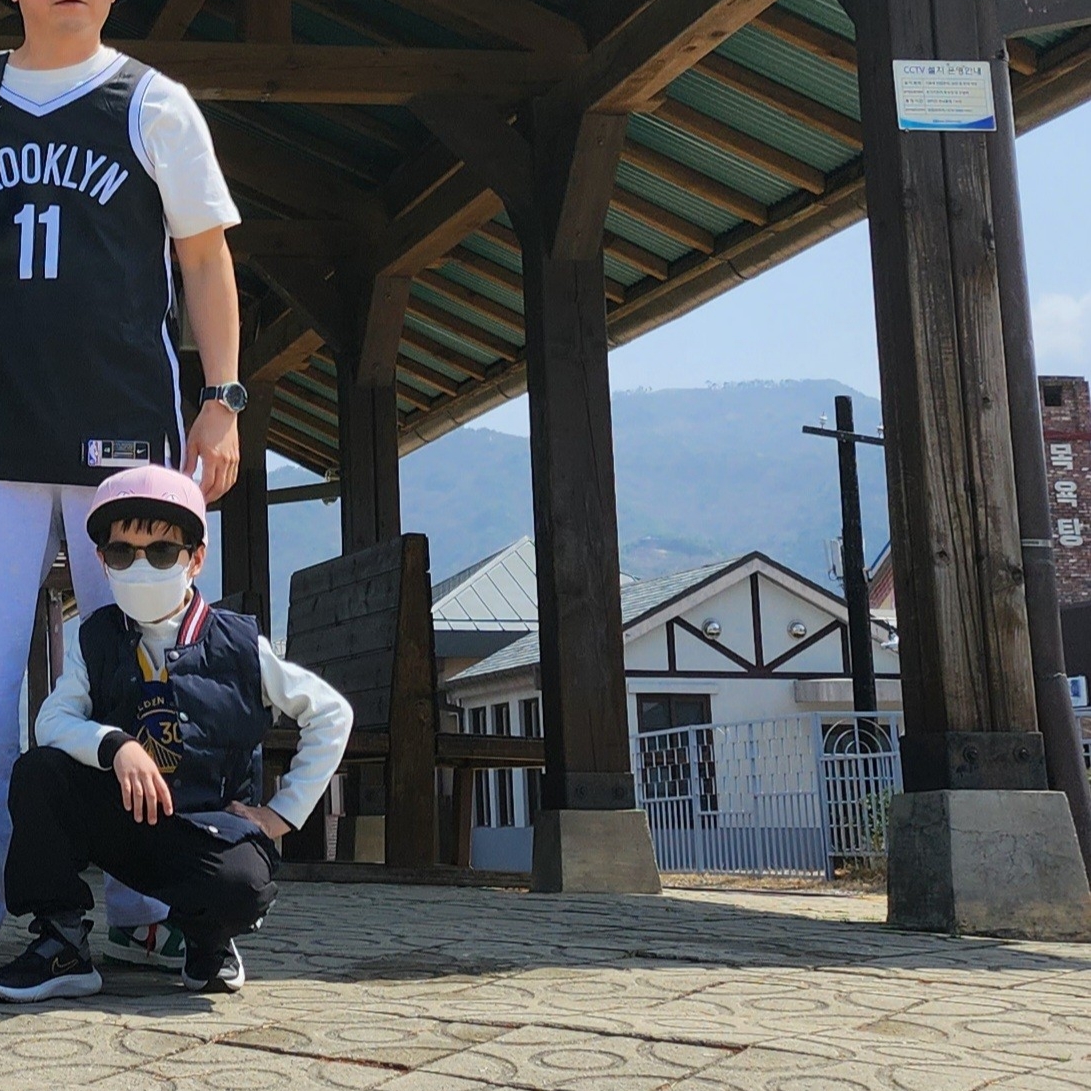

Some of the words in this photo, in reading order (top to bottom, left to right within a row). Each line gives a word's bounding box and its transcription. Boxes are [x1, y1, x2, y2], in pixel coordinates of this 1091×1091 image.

[903, 65, 926, 75] CCTV
[13, 203, 61, 280] 11
[1050, 443, 1084, 547] 목욕탕
